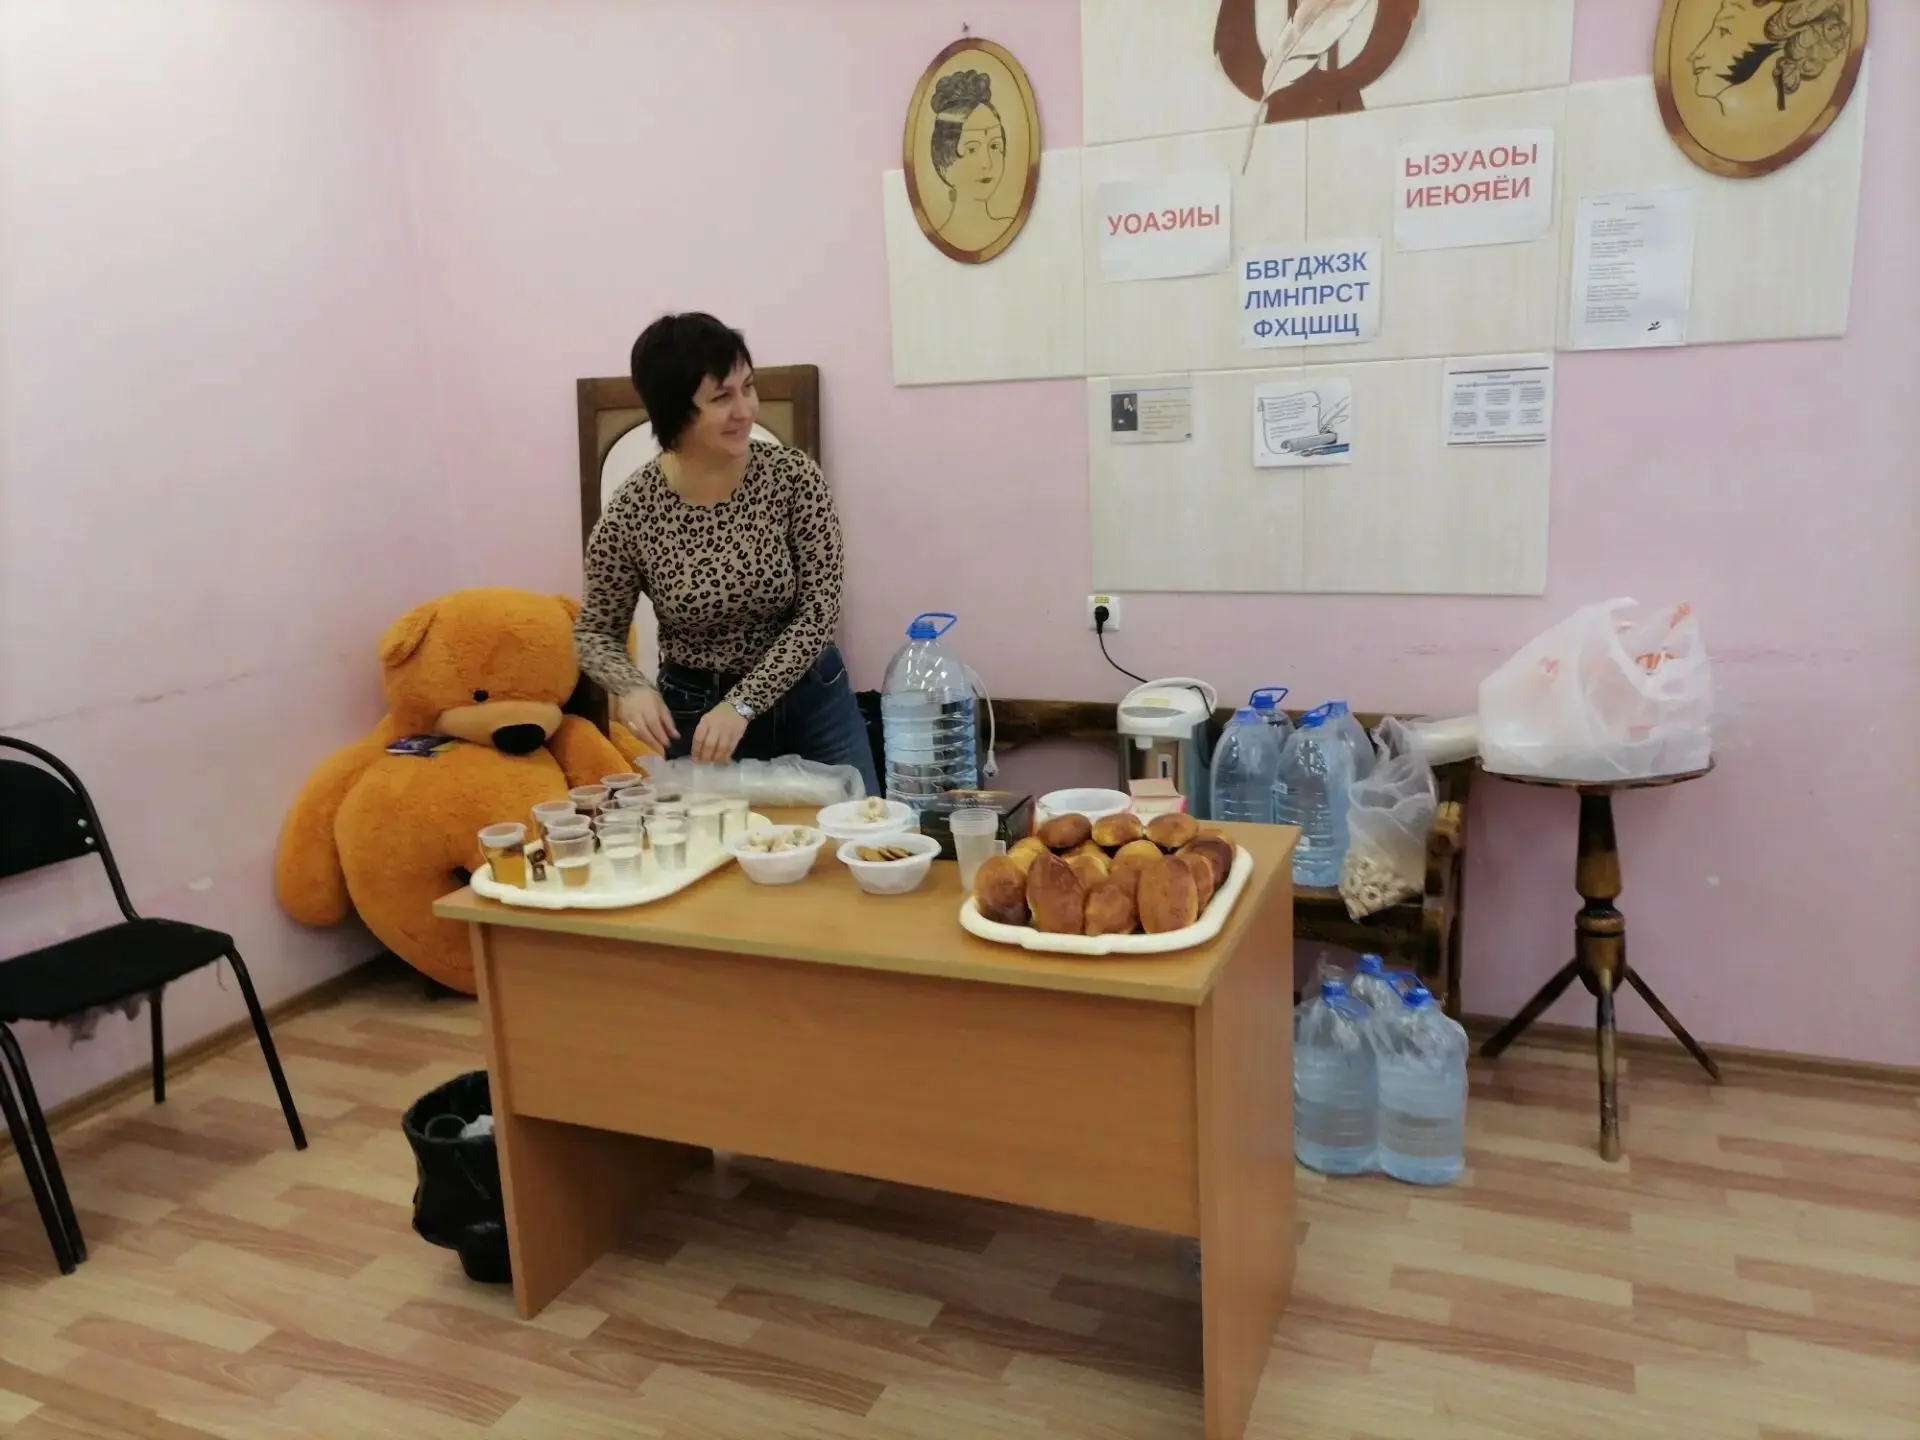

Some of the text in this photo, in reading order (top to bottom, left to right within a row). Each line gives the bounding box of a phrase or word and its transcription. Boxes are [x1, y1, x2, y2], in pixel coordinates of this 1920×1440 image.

[1405, 143, 1537, 177] ЫЭУАОЫ
[1406, 174, 1531, 209] ИЕЮЯЁИ
[1107, 204, 1220, 236] УОАЭИЫ
[1245, 251, 1368, 281] БВГДЖЗК
[1244, 281, 1370, 310] ЛМНПРСТ
[1253, 312, 1360, 340] ФХЦШЩ
